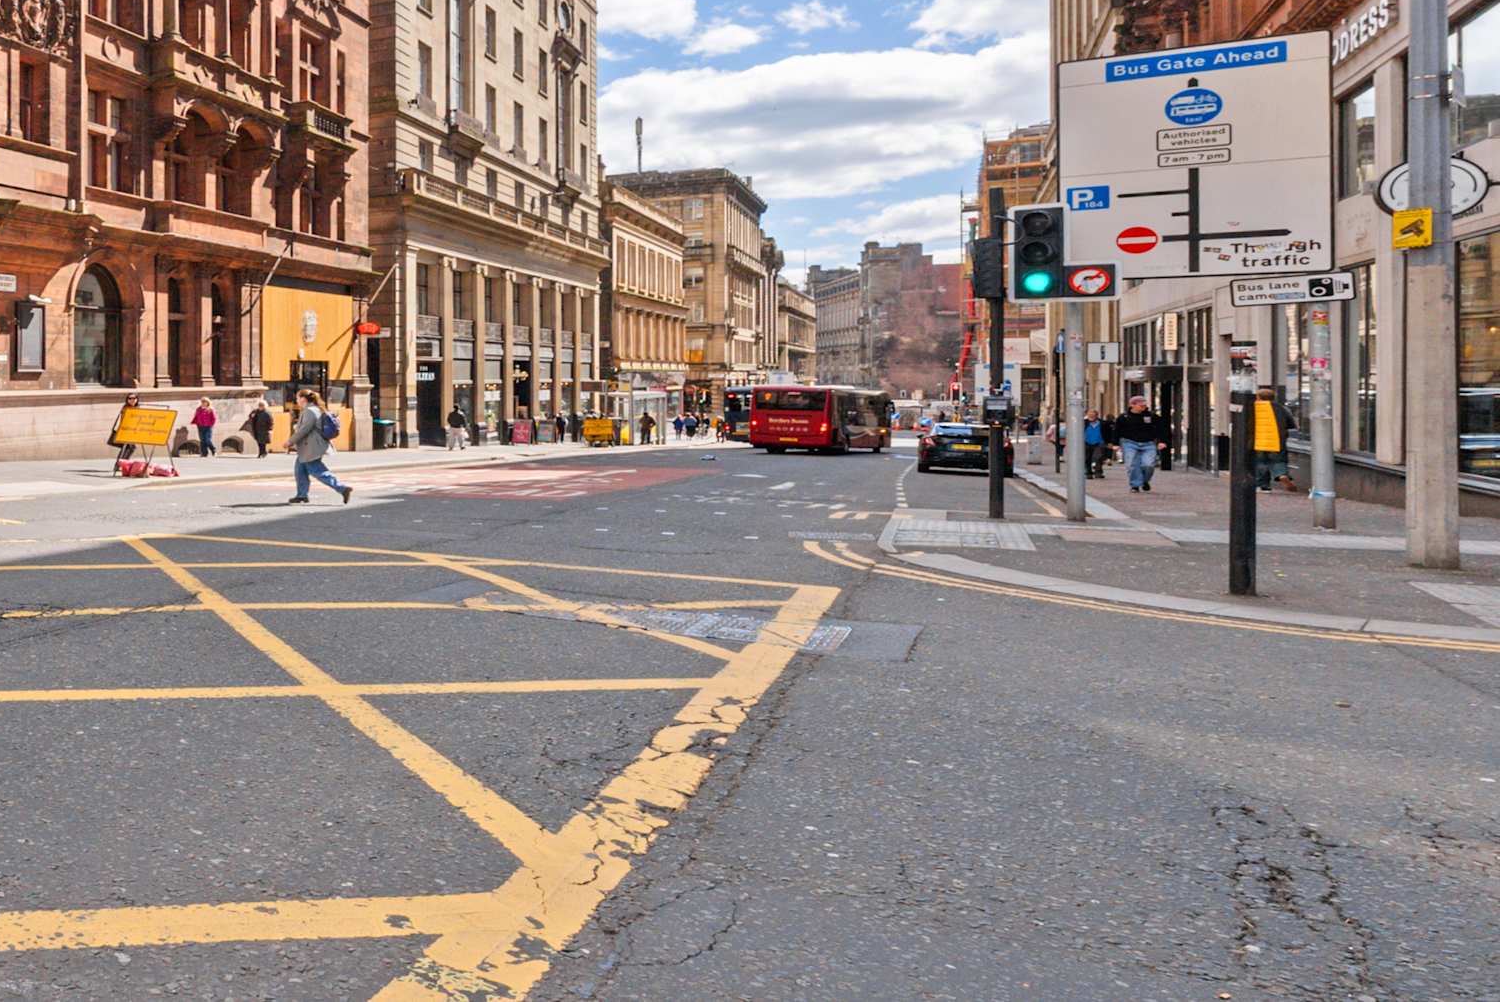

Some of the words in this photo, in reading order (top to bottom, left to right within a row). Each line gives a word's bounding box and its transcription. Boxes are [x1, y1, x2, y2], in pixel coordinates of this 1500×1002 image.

[1113, 64, 1149, 77] Bus
[1157, 57, 1206, 71] Gate
[1213, 46, 1279, 65] Ahead
[1162, 127, 1226, 140] Authorised
[1171, 136, 1217, 147] vehicles
[1072, 189, 1094, 209] P
[1241, 254, 1311, 268] traffic
[1237, 283, 1264, 292] Bus
[1268, 281, 1300, 291] lane
